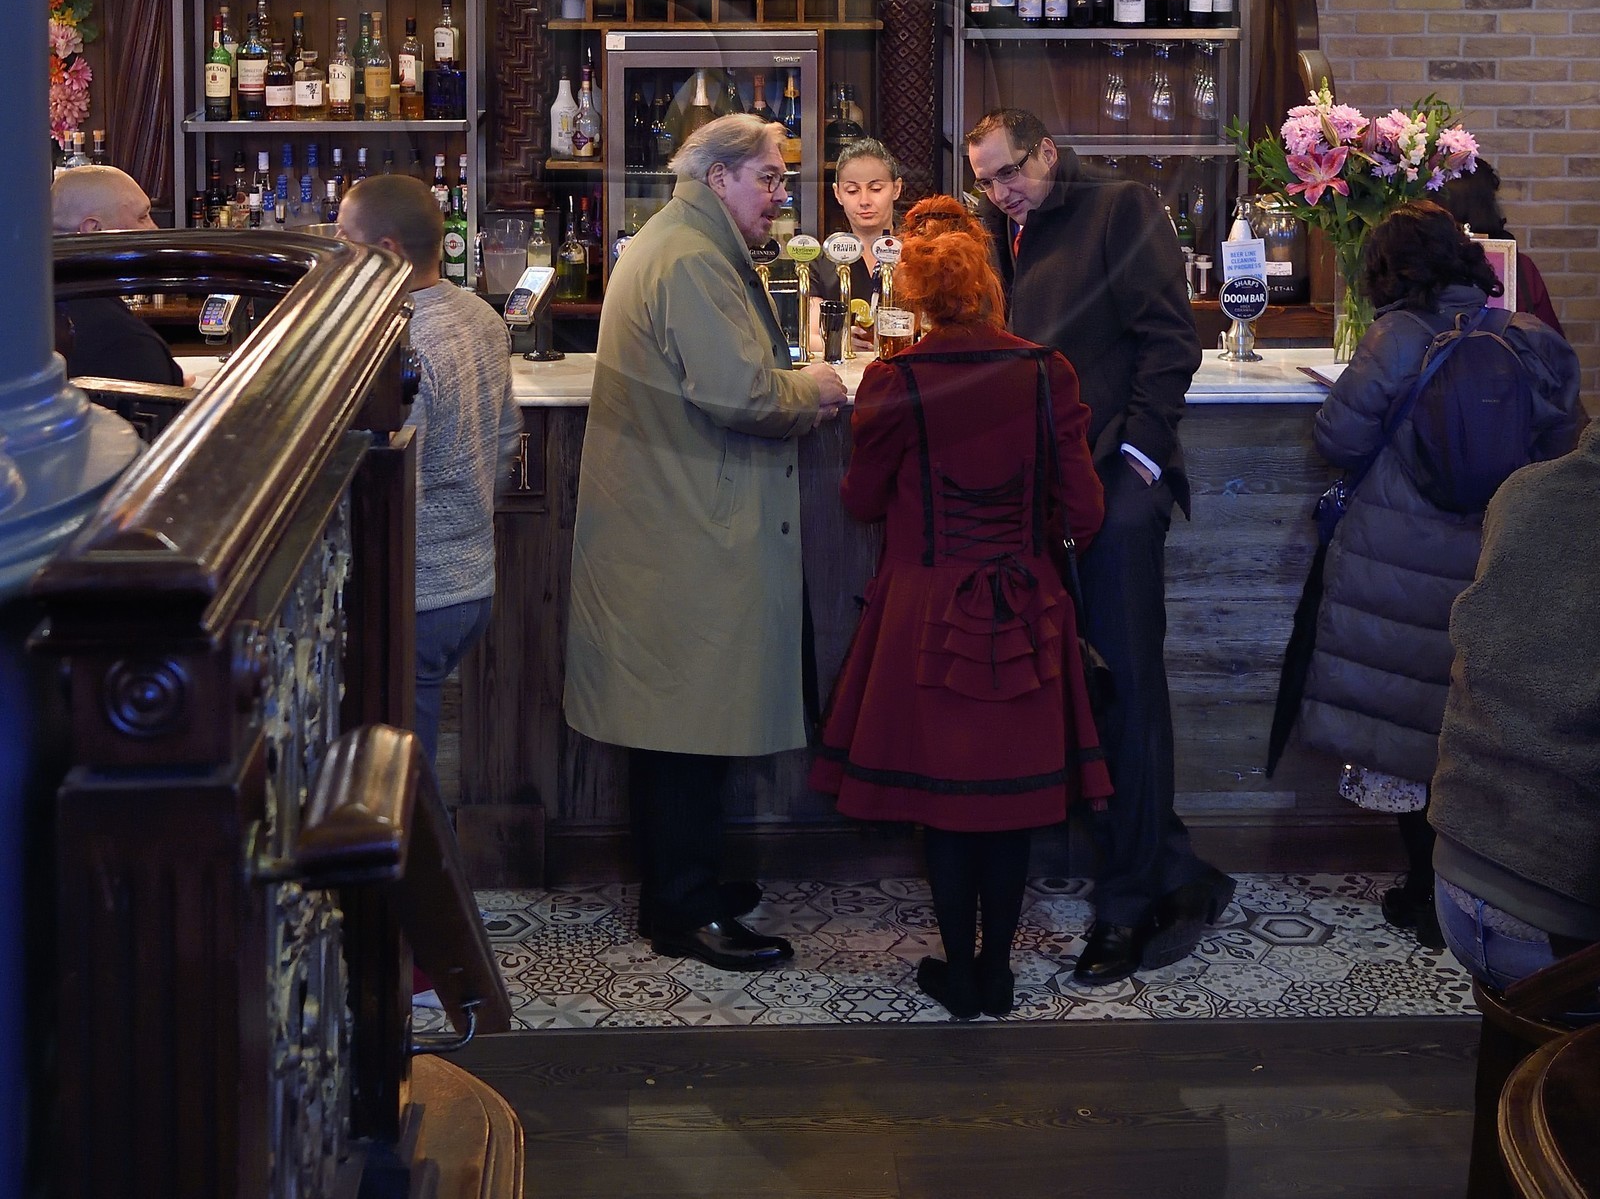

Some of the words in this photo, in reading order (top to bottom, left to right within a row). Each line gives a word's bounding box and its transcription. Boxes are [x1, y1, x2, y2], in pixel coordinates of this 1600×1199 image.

[833, 243, 857, 252] PRAVHA
[1224, 293, 1249, 303] DOOM
[1250, 293, 1265, 302] BAR
